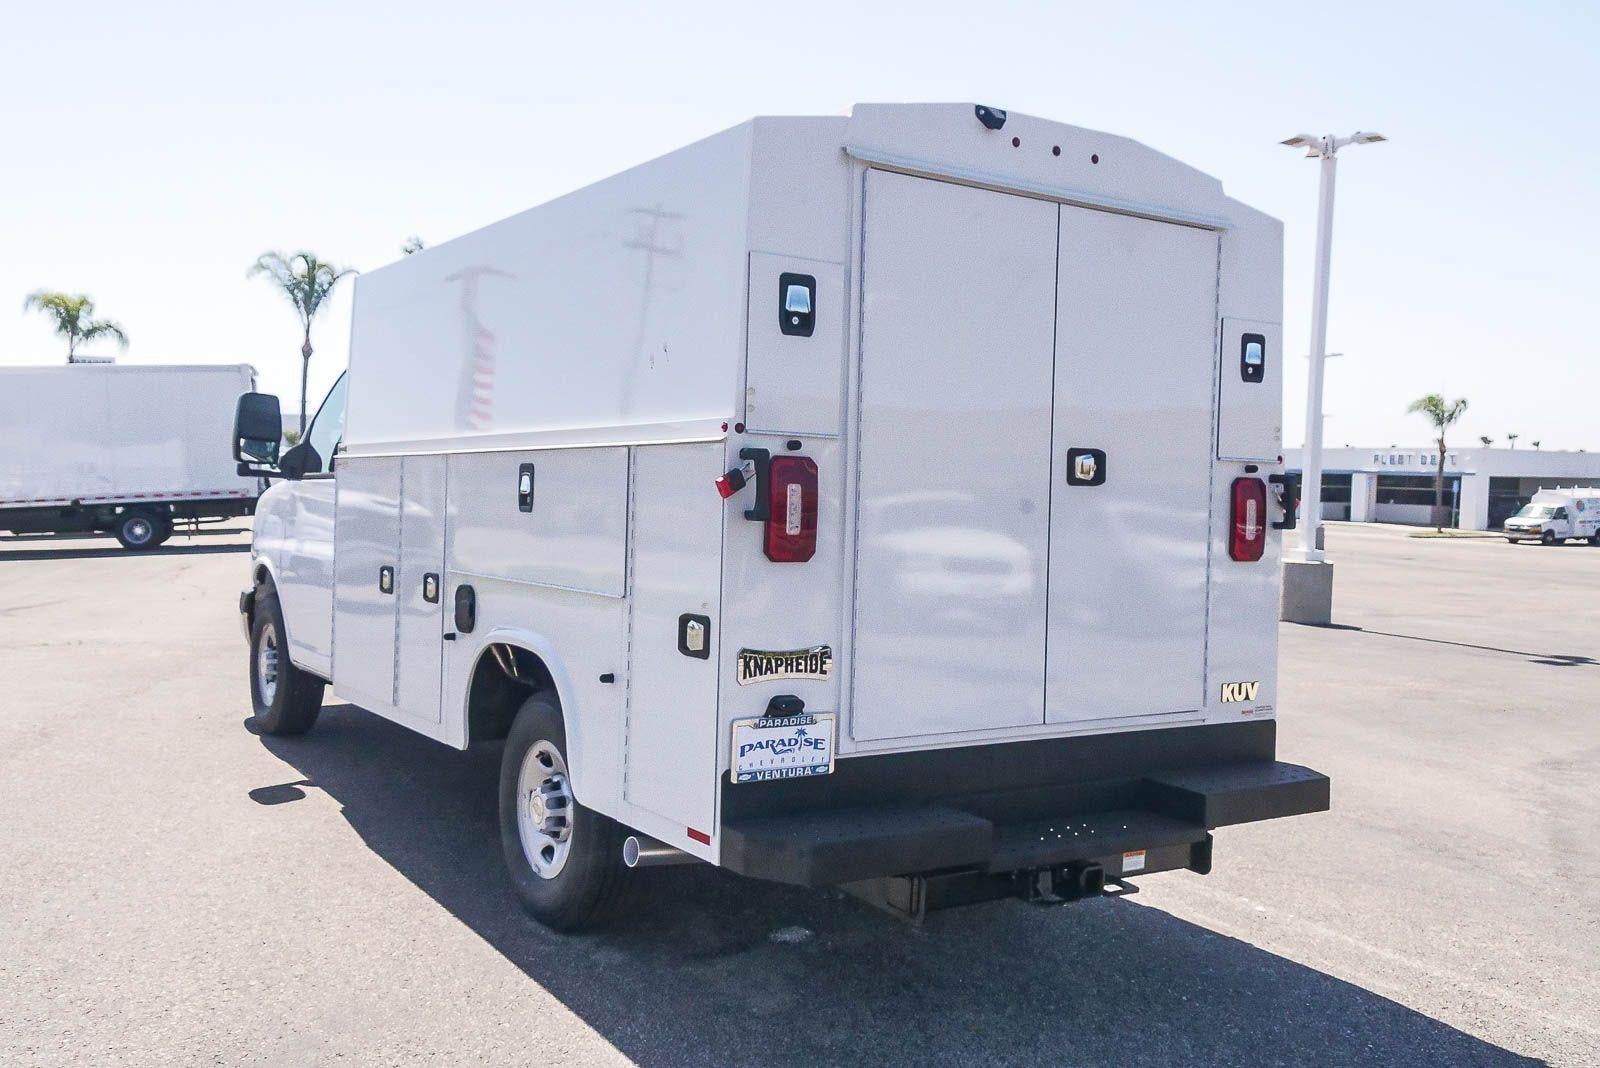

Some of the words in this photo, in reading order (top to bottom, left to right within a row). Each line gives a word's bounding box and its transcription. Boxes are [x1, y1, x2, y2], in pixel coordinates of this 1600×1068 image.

[1420, 454, 1457, 466] DET
[742, 651, 829, 680] KNAPHEIDE
[1220, 681, 1260, 703] KUV
[759, 716, 812, 728] PARADISE
[739, 729, 826, 757] PARADISE
[756, 768, 812, 780] VENTURA
